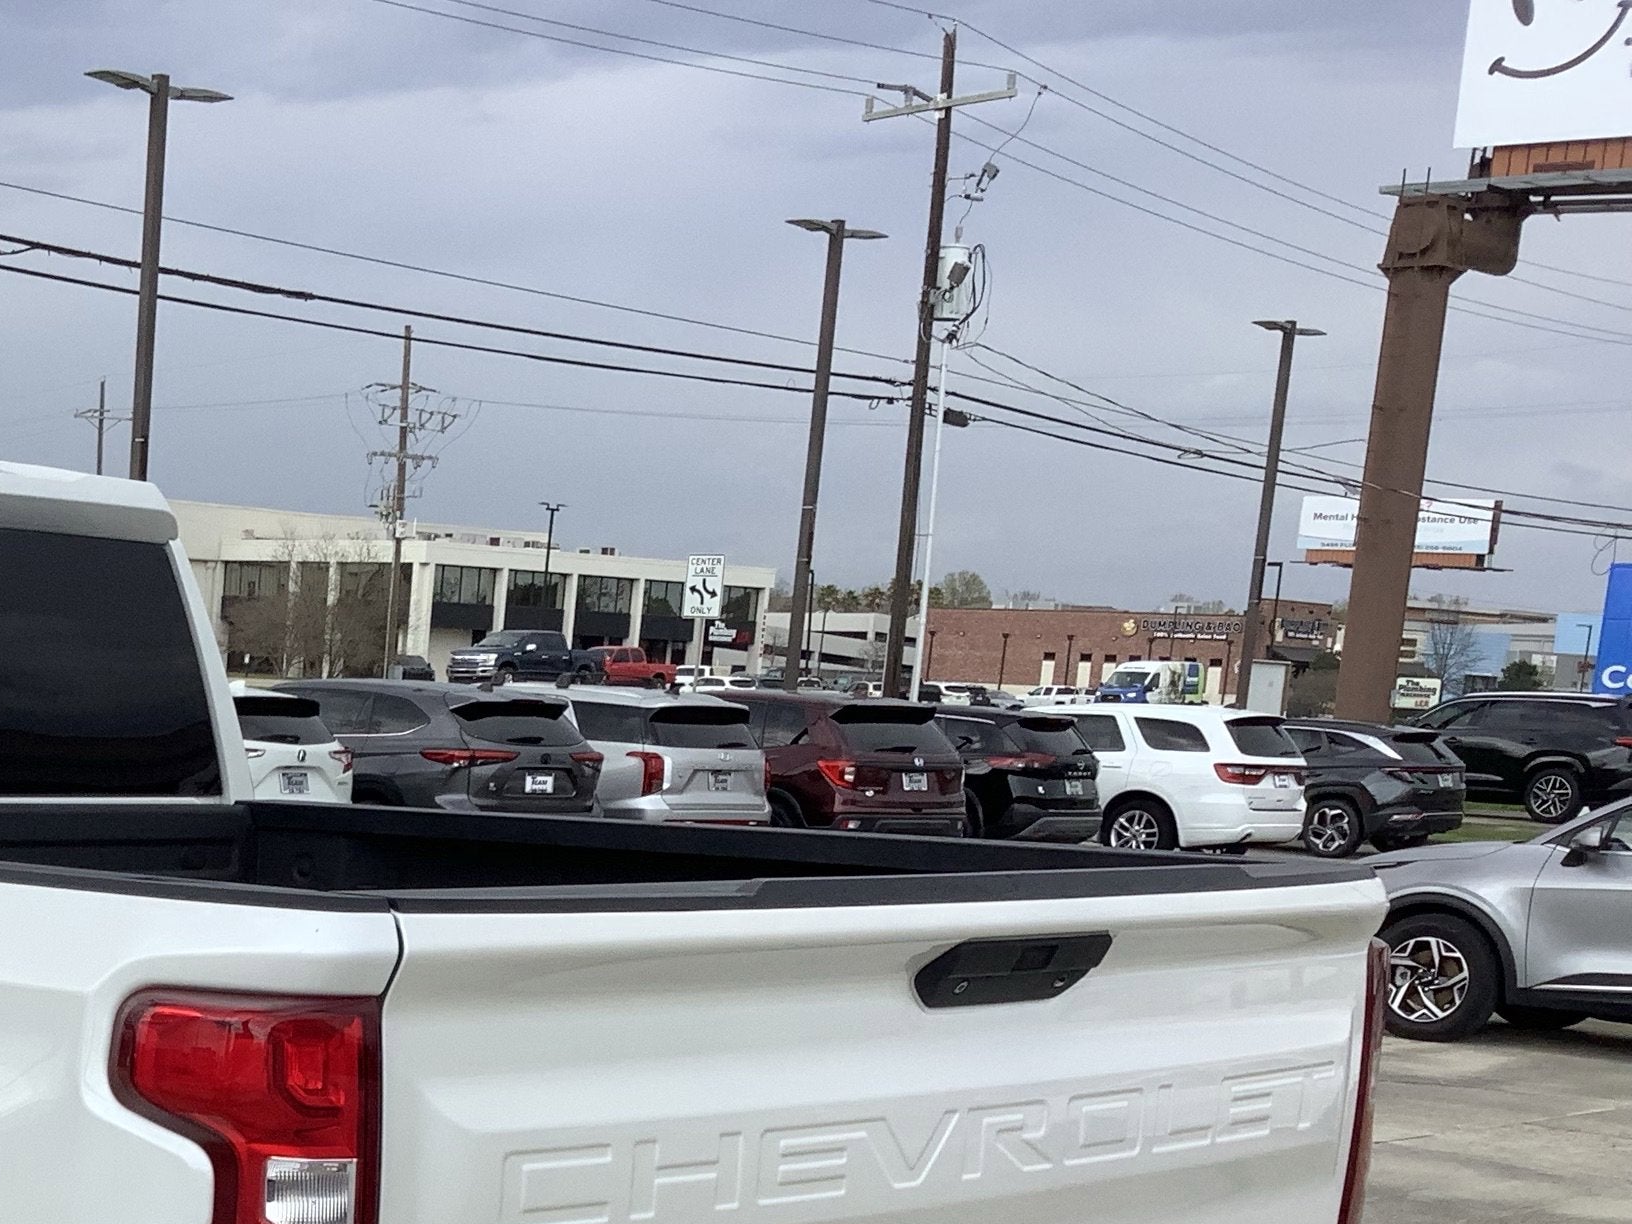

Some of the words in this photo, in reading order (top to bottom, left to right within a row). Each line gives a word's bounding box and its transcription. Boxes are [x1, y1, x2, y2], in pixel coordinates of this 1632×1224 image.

[1313, 512, 1348, 521] Mental
[691, 557, 722, 566] CENTER
[694, 566, 716, 574] LANE
[690, 606, 712, 614] ONLY
[1141, 619, 1204, 632] DUMPLING
[1205, 621, 1215, 632] &
[1217, 621, 1242, 633] BAO
[1399, 684, 1437, 696] Plumbing
